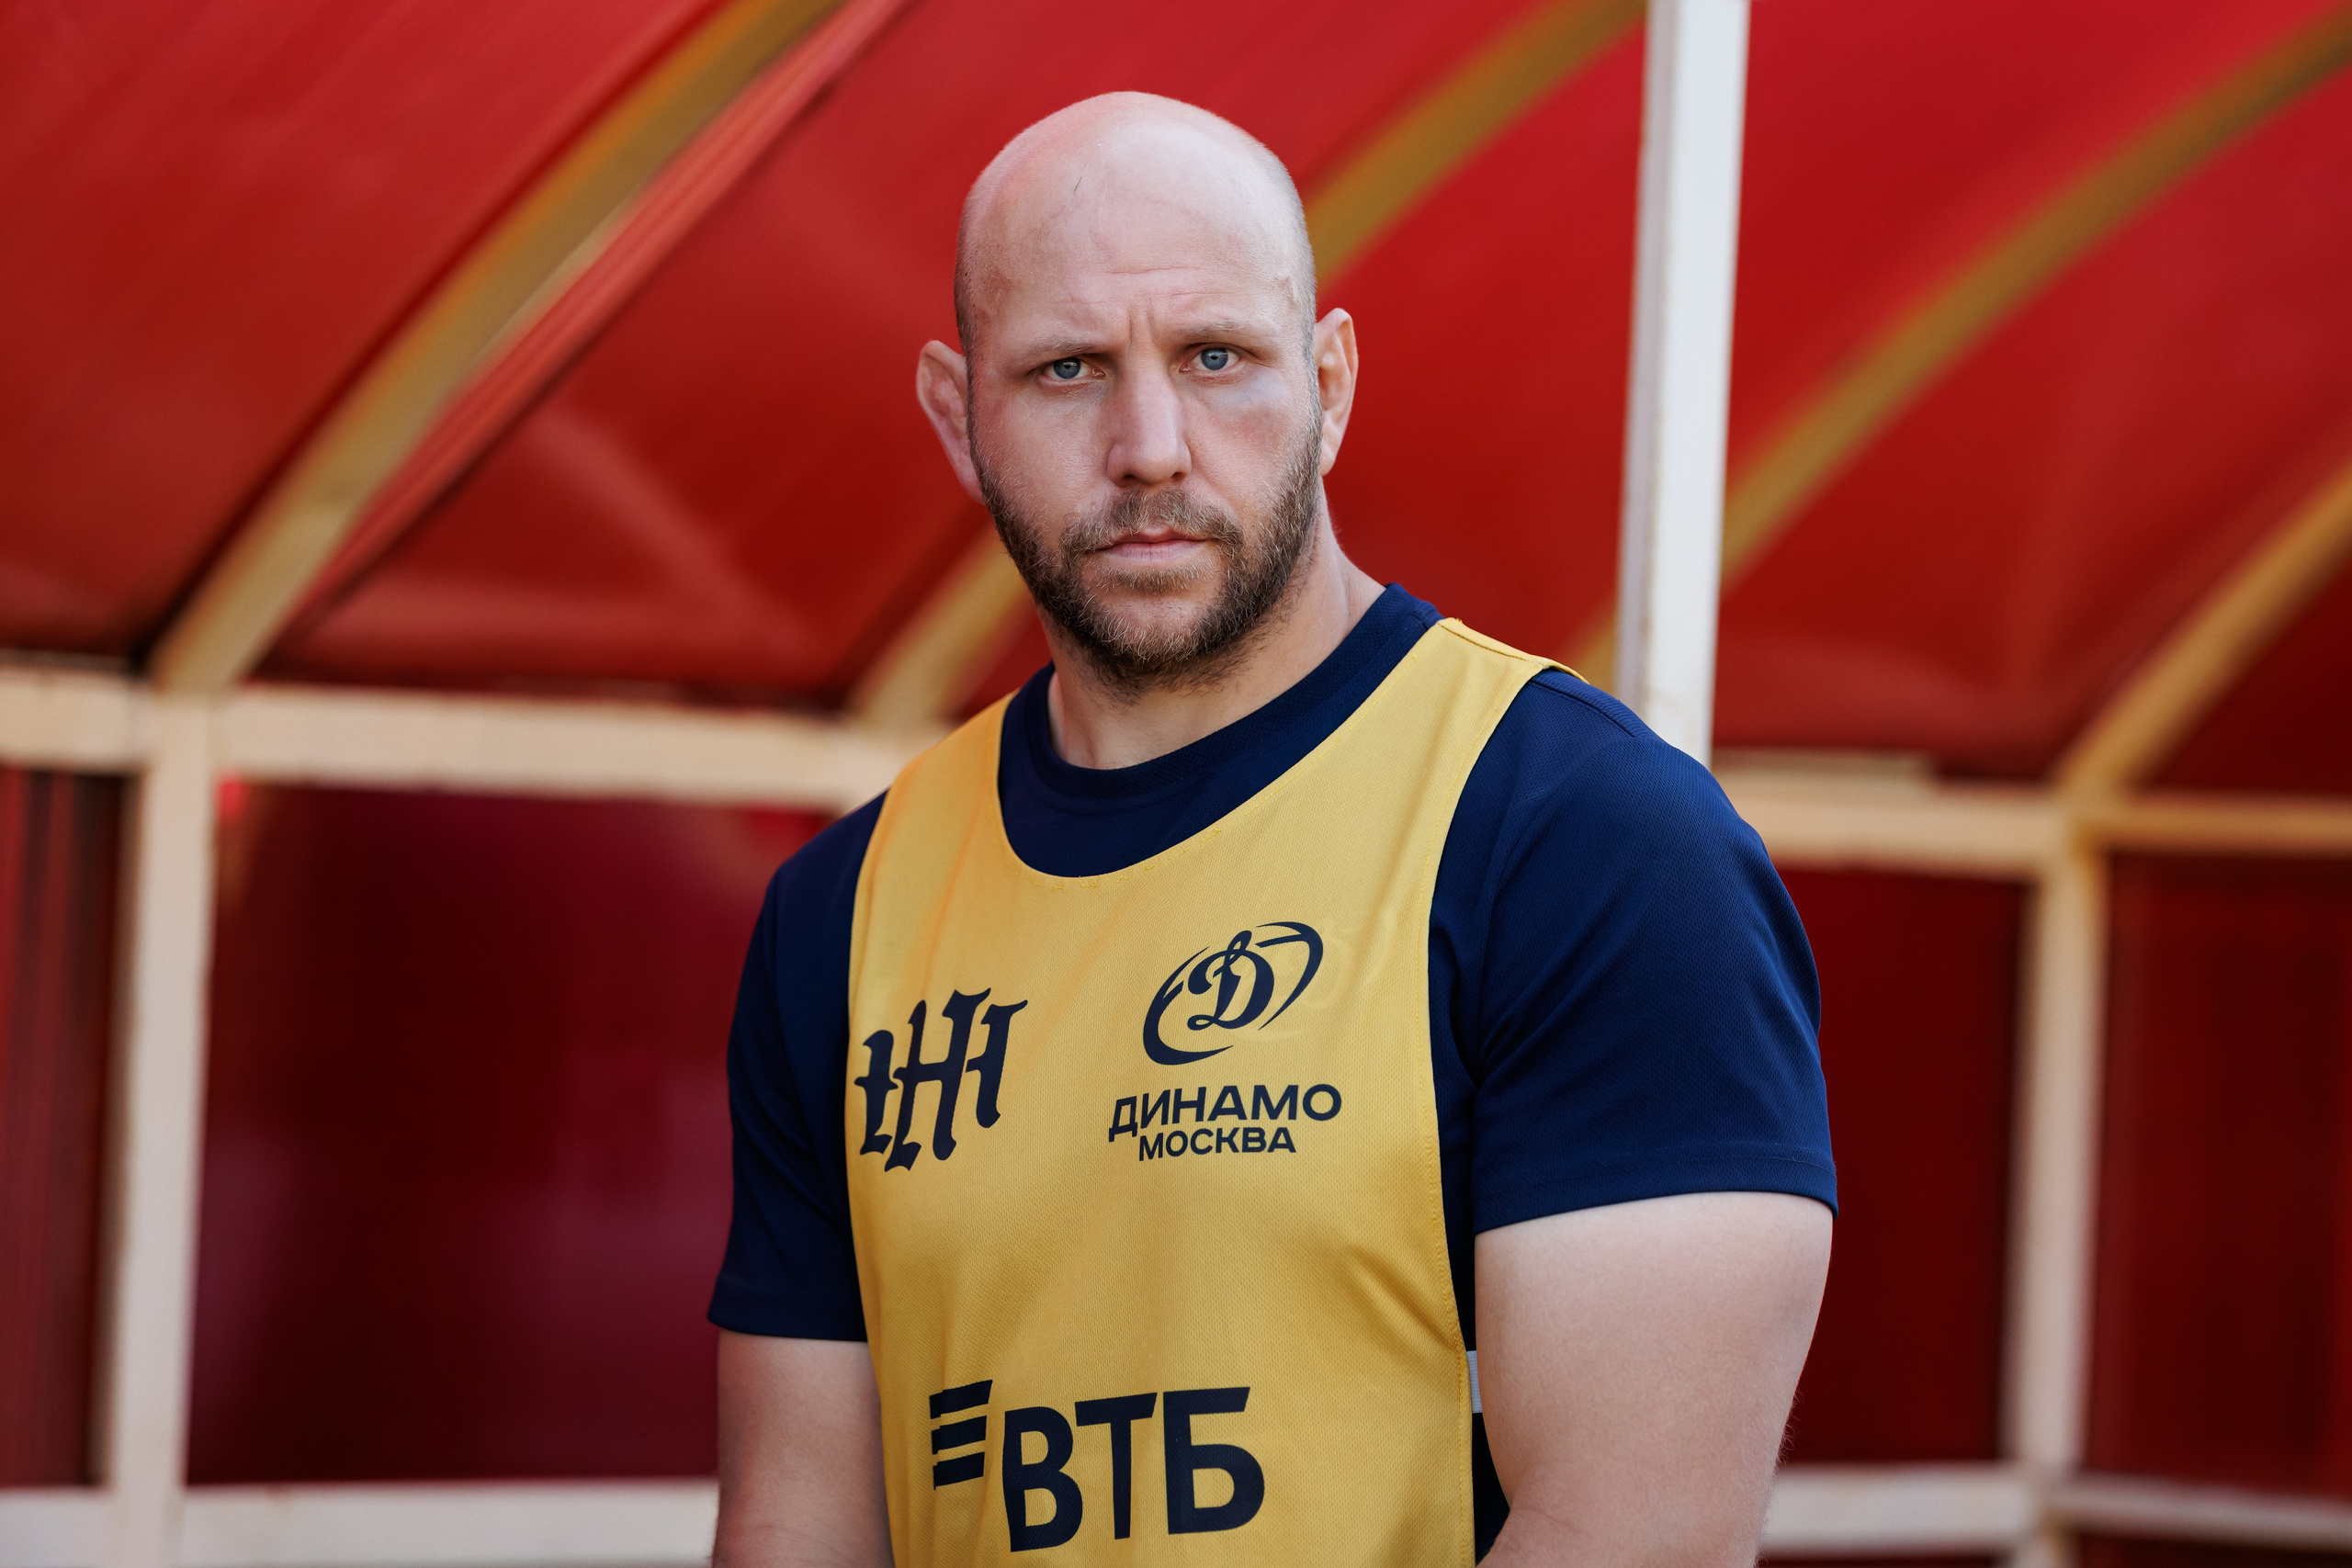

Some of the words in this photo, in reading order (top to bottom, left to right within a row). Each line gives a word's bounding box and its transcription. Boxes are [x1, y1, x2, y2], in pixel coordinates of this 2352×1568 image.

[1108, 1084, 1342, 1142] ДИНАМО
[1138, 1127, 1296, 1161] МОСКВА
[1002, 1387, 1265, 1552] ВТБ
